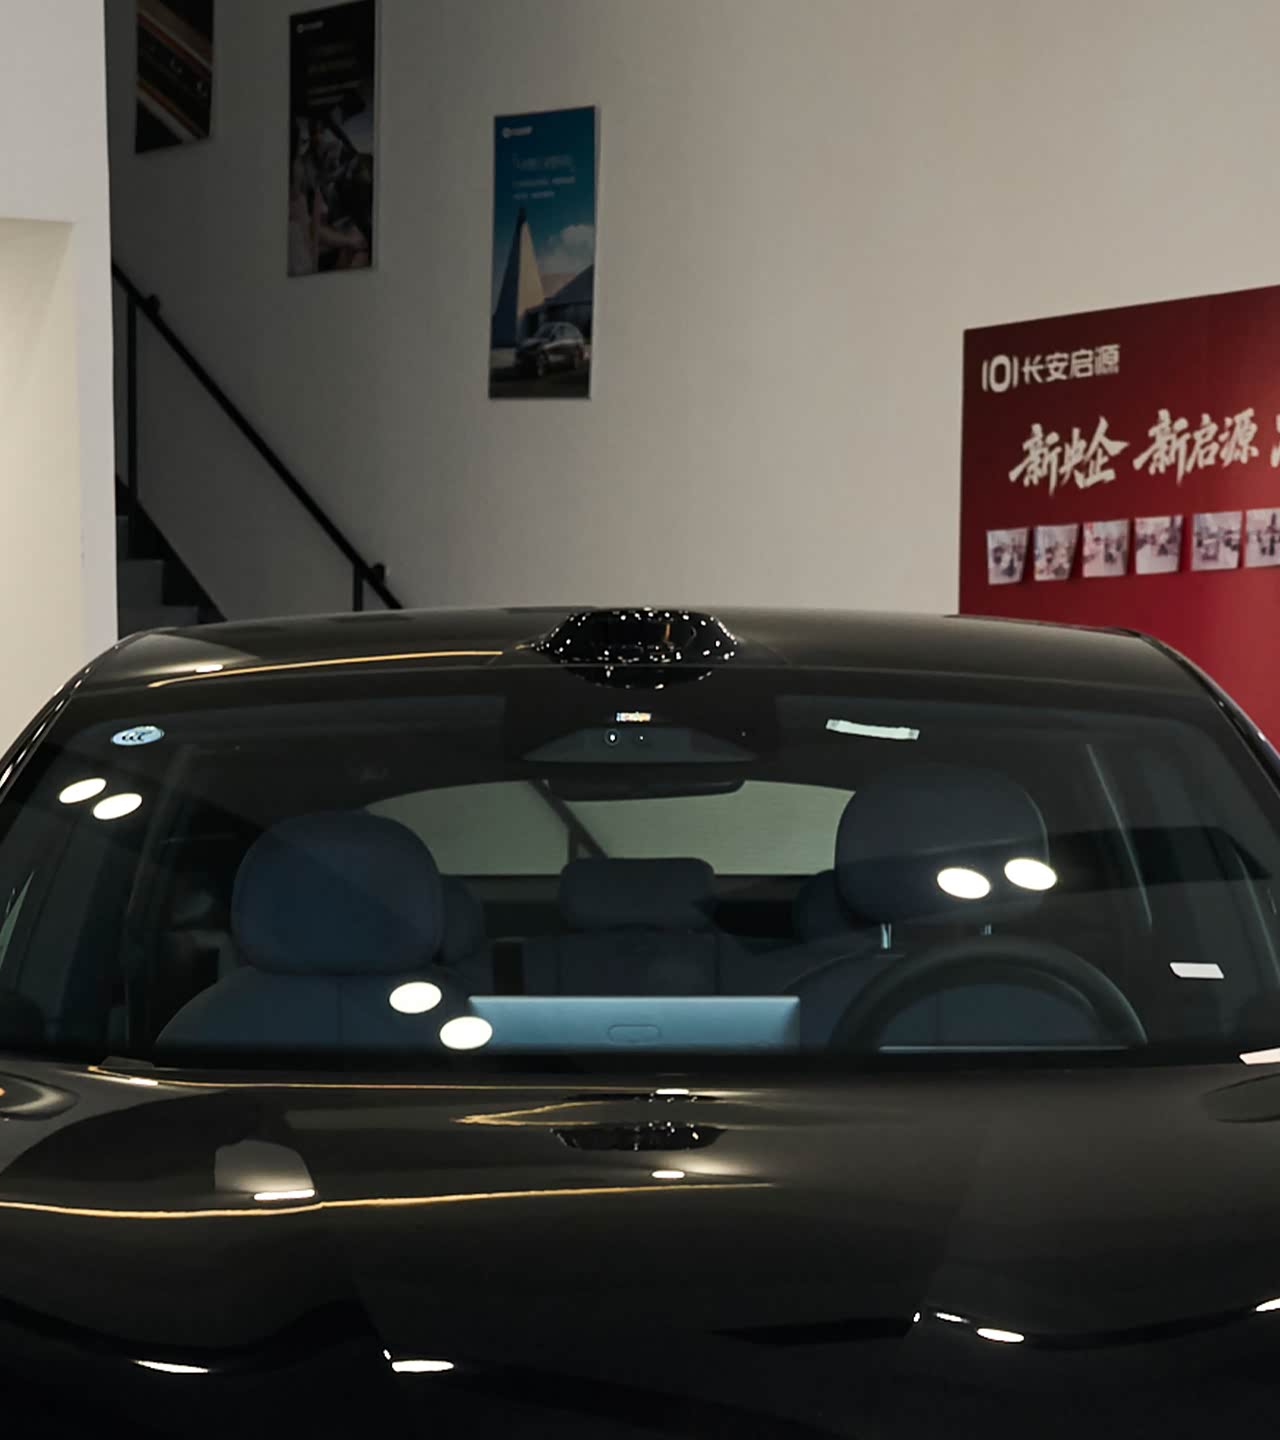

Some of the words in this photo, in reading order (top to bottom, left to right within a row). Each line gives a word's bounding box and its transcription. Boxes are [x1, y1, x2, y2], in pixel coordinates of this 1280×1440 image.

[1021, 343, 1121, 386] 长安启源
[1008, 416, 1130, 497] 新央企
[1132, 407, 1261, 487] 新启源
